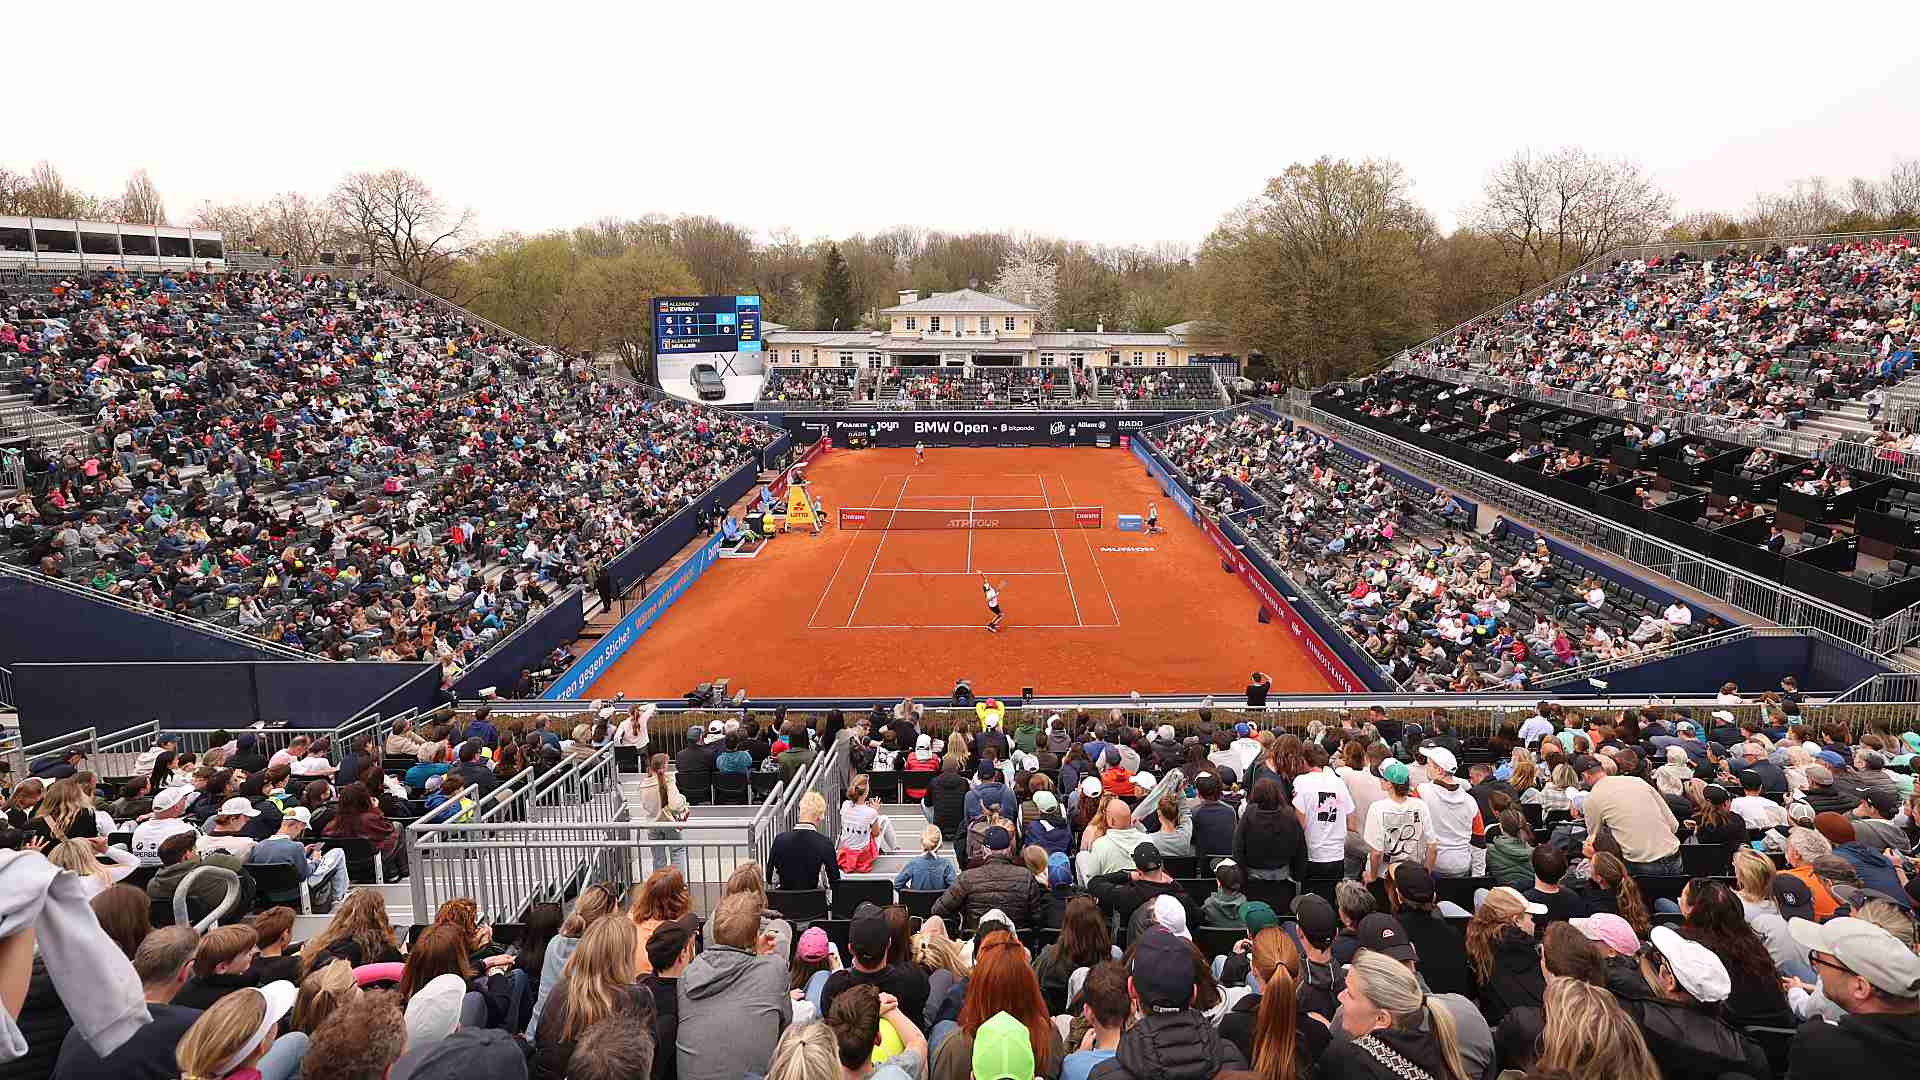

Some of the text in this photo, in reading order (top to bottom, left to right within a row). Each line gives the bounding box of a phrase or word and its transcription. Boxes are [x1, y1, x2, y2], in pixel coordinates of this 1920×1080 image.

[685, 316, 692, 324] 2
[723, 326, 730, 334] 0
[914, 421, 989, 436] BMW Open
[578, 654, 604, 689] gegen
[605, 626, 631, 660] Stiche?
